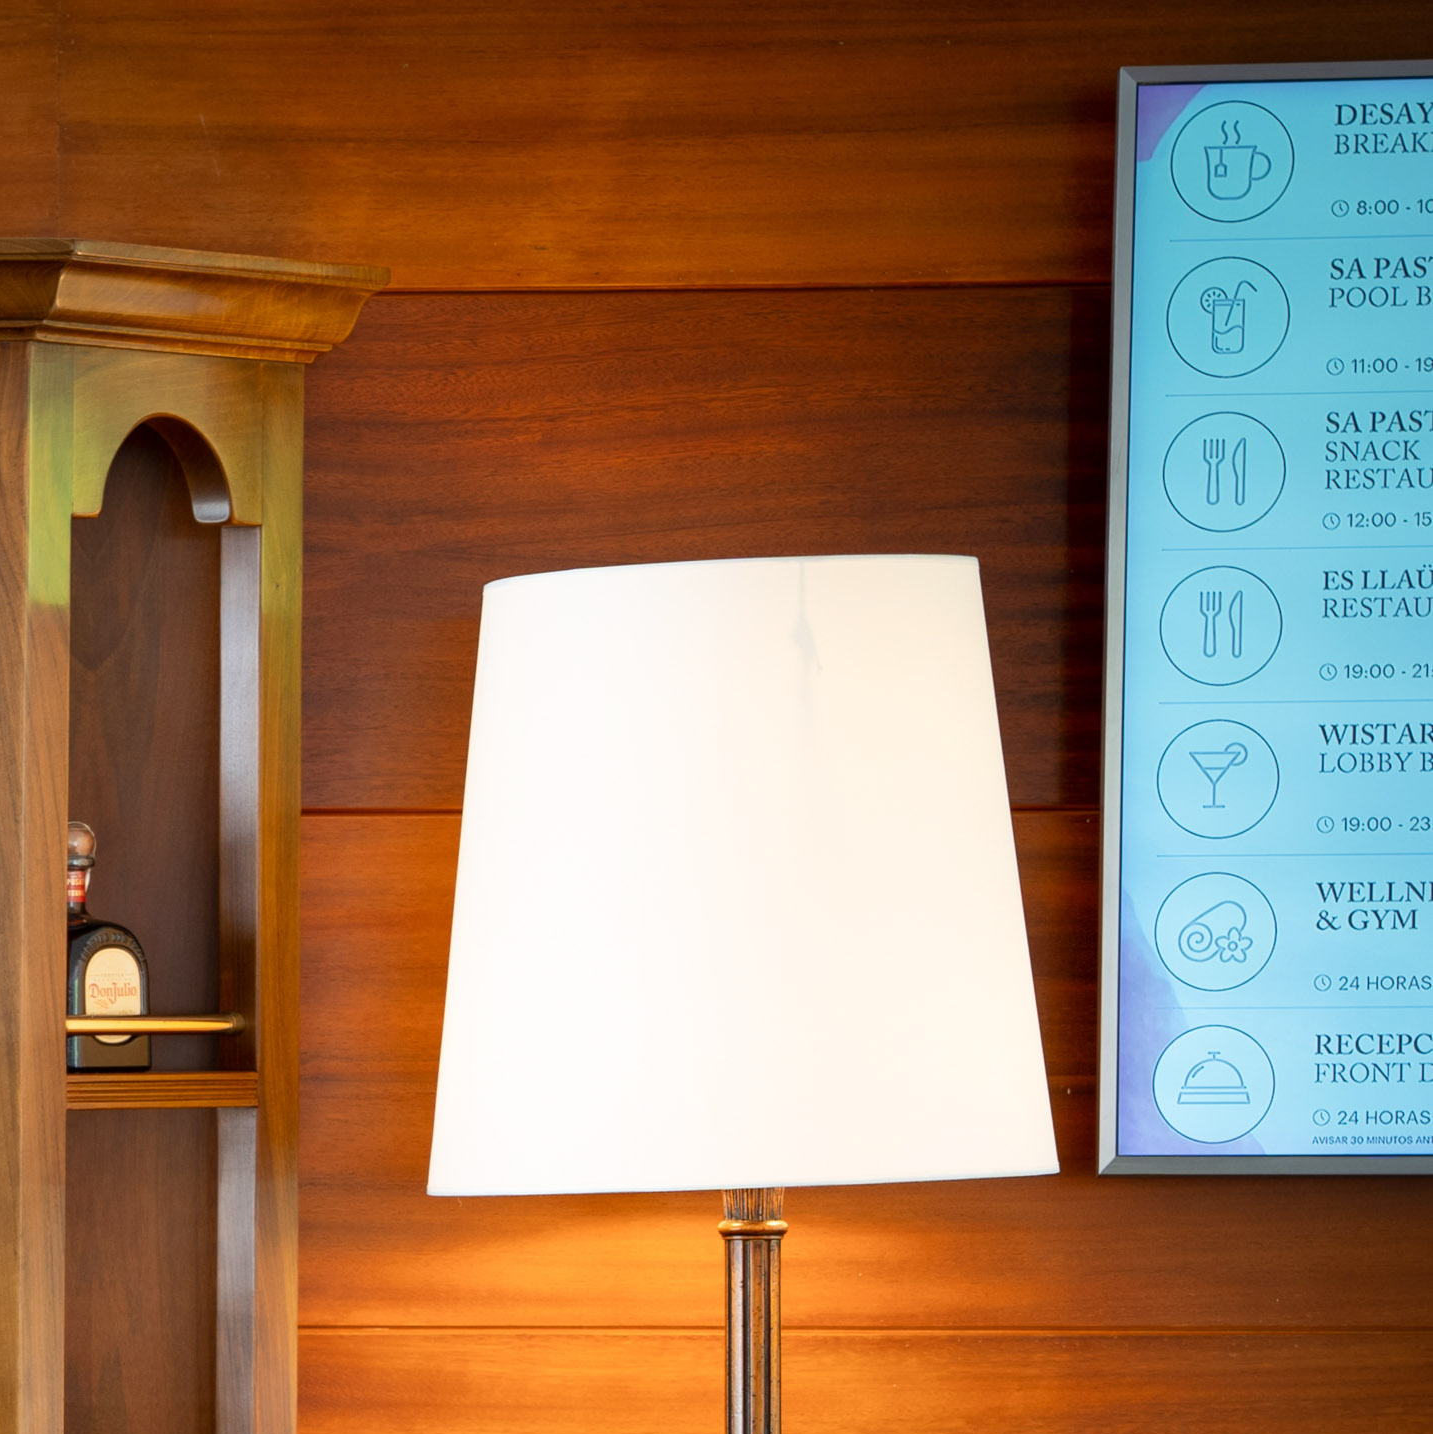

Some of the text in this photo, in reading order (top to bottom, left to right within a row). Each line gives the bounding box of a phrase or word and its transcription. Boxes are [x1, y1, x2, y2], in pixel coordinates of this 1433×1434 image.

[1334, 101, 1433, 126] DESAY
[1334, 131, 1433, 155] BREAK
[1356, 199, 1399, 215] 8:00
[1417, 198, 1433, 214] 10
[1330, 255, 1433, 281] SA PAS
[1328, 284, 1408, 308] POOL
[1351, 357, 1398, 374] 11:00
[1415, 356, 1433, 373] 19
[1326, 411, 1363, 434] SA
[1325, 440, 1421, 462] SNACK
[1324, 468, 1433, 490] RESTAU
[1347, 512, 1397, 528] 12:00
[1414, 511, 1433, 527] 15
[1322, 563, 1433, 591] ES LLAÜ
[1322, 596, 1433, 618] RESTAU
[1344, 663, 1395, 679] 19:00
[1317, 722, 1433, 746] WISTAR
[1318, 751, 1433, 774] LOBBY B
[1341, 816, 1392, 832] 19:00
[1316, 908, 1419, 931] & GYM
[1338, 975, 1433, 991] 24 HORAS
[1314, 1032, 1433, 1056] RECEPC
[1314, 1061, 1412, 1084] FRONT
[1337, 1109, 1432, 1126] 24 HORAS
[1311, 1135, 1348, 1145] AVISAR
[1350, 1135, 1364, 1145] 30
[1366, 1135, 1413, 1145] MINUTOS
